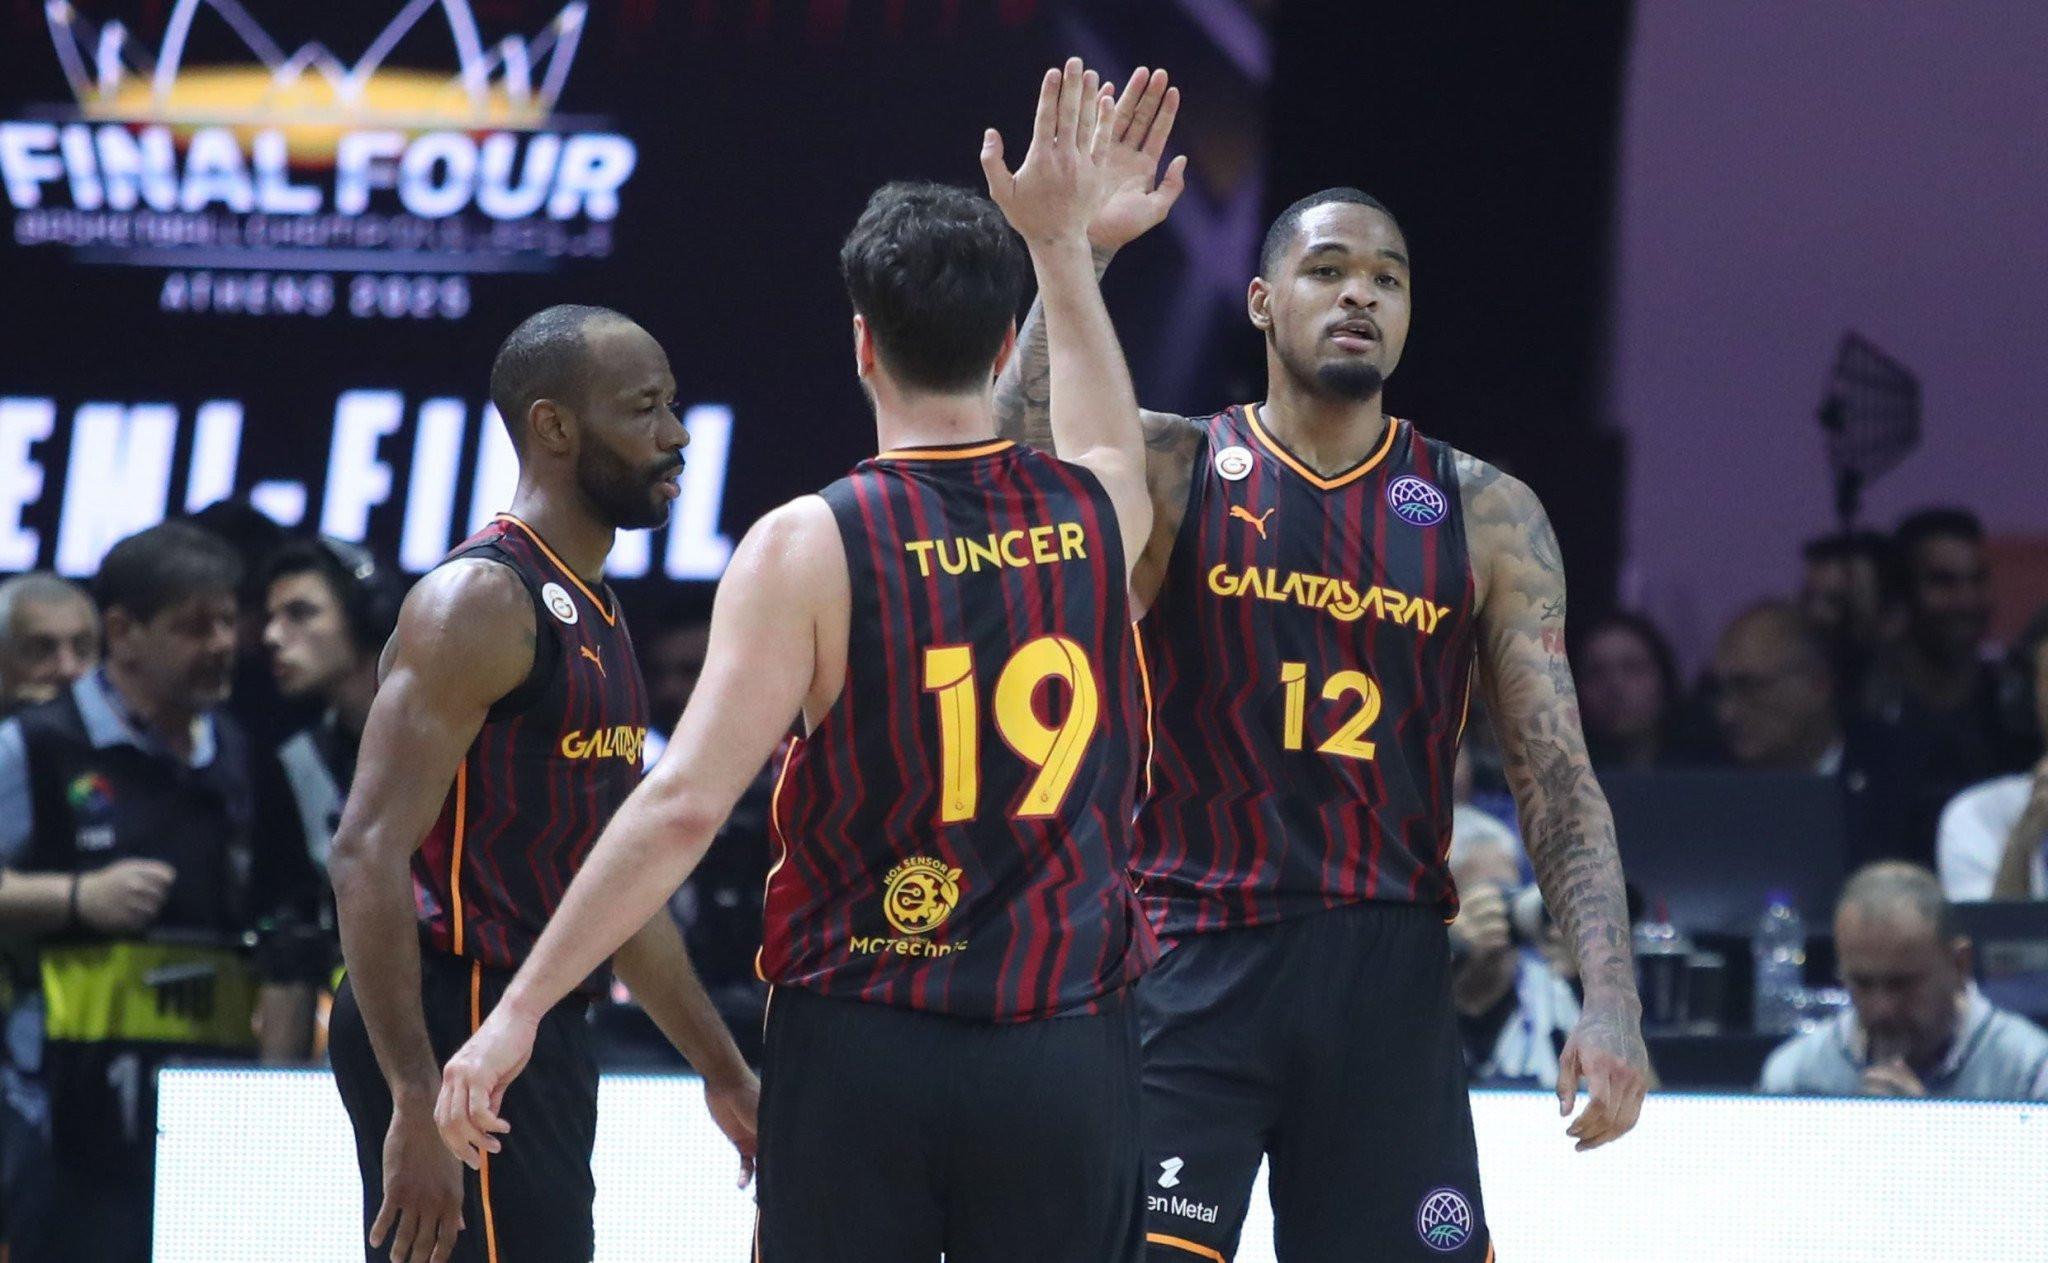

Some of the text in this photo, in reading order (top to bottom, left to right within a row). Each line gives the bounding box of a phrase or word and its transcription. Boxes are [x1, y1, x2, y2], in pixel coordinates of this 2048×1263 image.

[0, 120, 638, 222] FINAL FOUR
[159, 271, 335, 316] ATHENS
[904, 521, 1087, 578] TUNCER
[1207, 562, 1451, 635] GALATASARAY
[923, 634, 1100, 825] 19
[1280, 661, 1382, 761] 12
[903, 855, 949, 875] SENSOR
[1170, 1195, 1219, 1224] Metal
